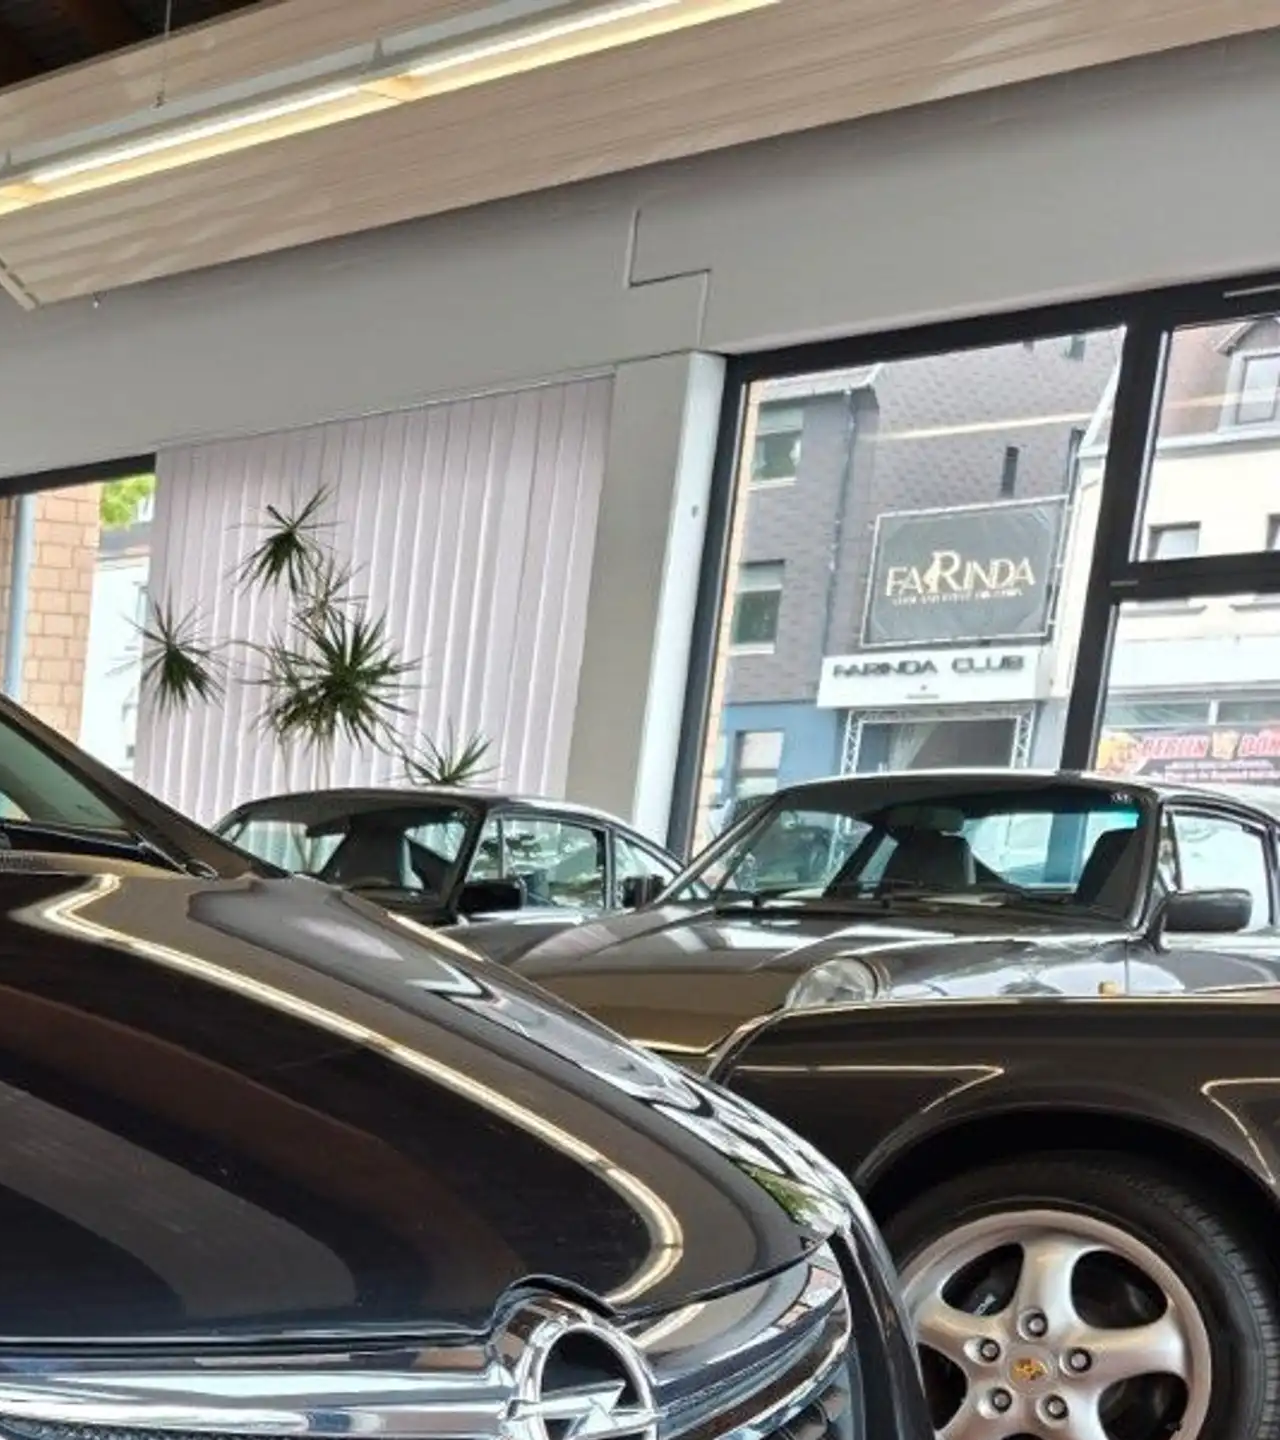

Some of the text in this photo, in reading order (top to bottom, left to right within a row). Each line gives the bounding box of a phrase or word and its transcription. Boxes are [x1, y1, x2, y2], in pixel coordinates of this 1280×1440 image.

[885, 549, 1037, 597] FARINDA
[833, 654, 1025, 678] FARINDA CLUB
